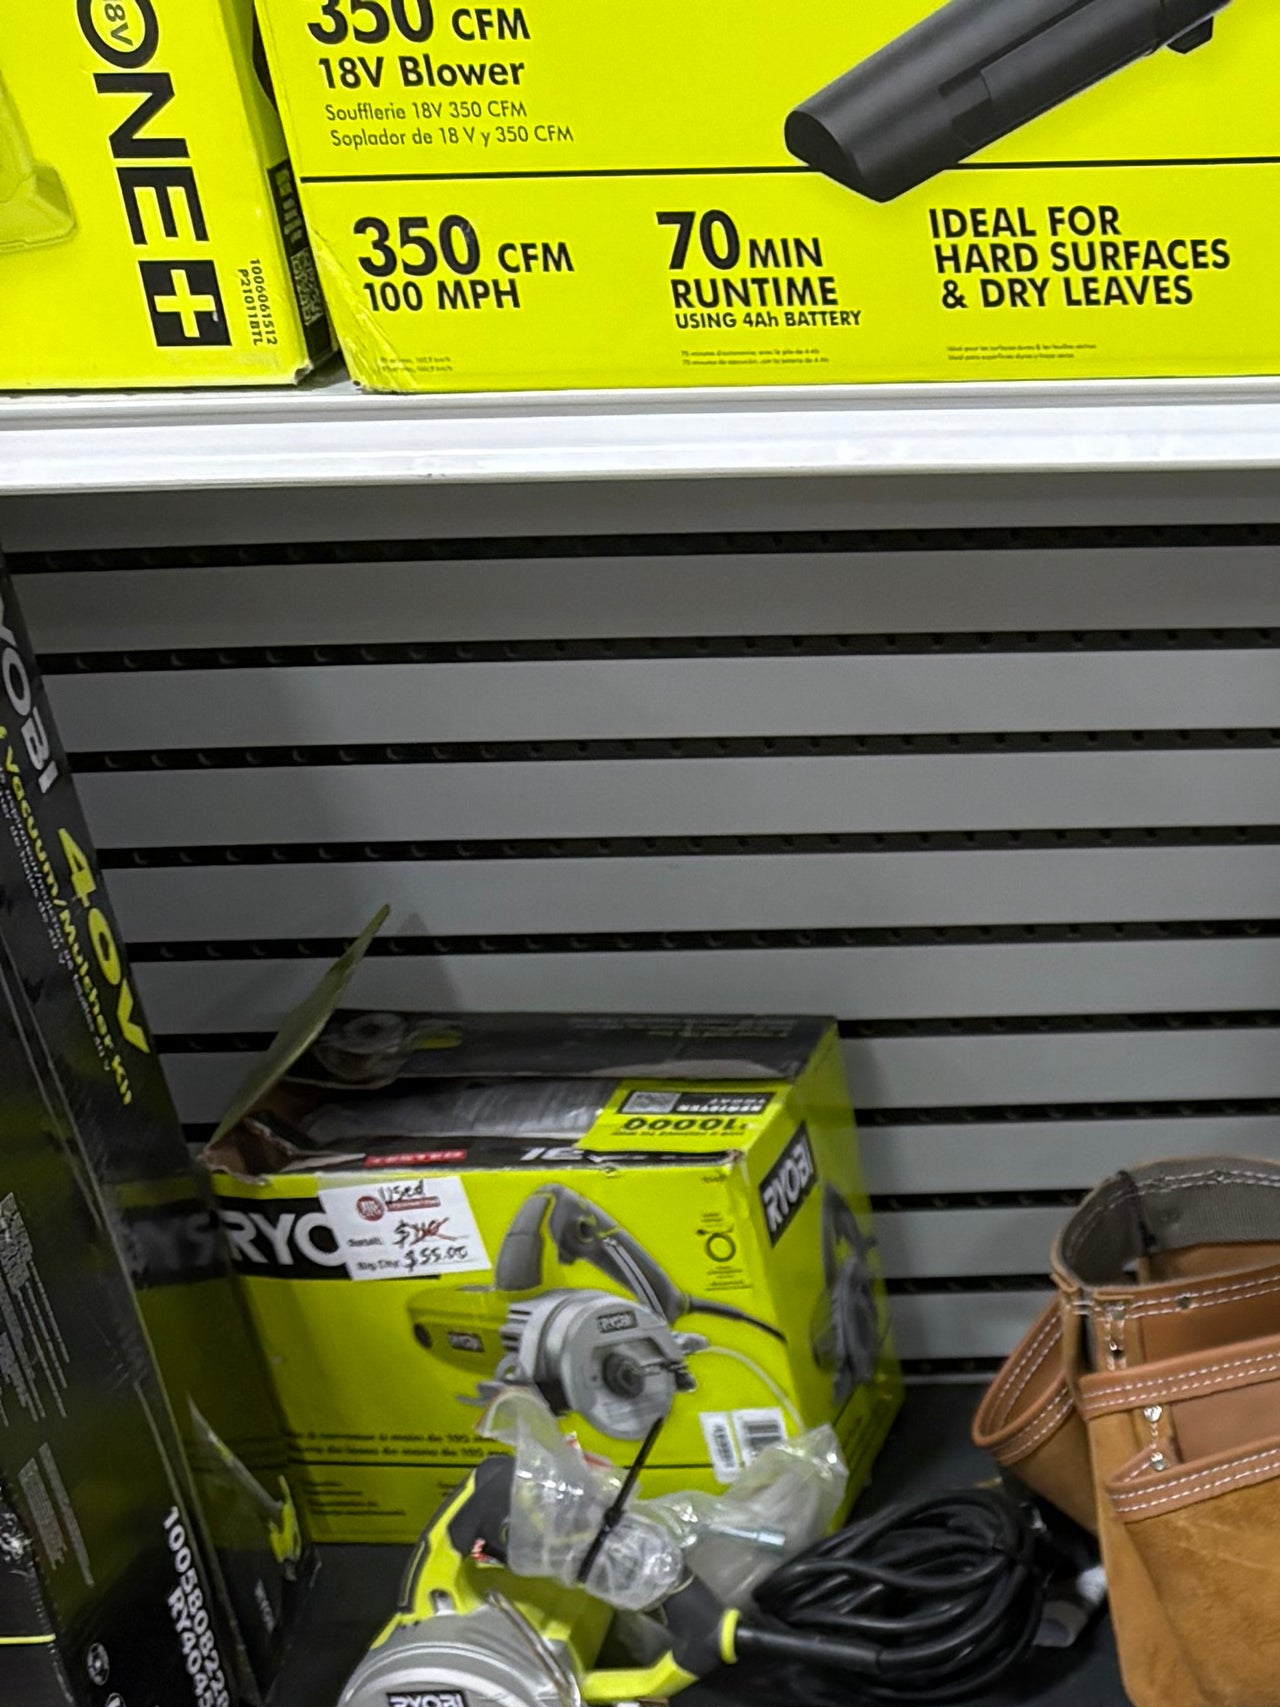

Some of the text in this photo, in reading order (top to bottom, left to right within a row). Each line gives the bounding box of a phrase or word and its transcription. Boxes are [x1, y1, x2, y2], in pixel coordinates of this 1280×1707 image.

[307, 0, 531, 45] 350 CFM
[318, 53, 525, 89] 18V Blower
[325, 100, 527, 121] Soufflerie 18V 350 CFM
[330, 125, 574, 150] Soplador de 18 V y 350 CFM
[655, 208, 823, 271] 70 MIN
[929, 205, 1122, 239] IDEAL FOR
[352, 213, 575, 278] 350 CFM
[934, 238, 1231, 274] HARD SURFACES
[364, 278, 521, 312] 100 MPH
[672, 276, 839, 309] RUNTIME
[941, 275, 1193, 309] & DRY LEAVES
[675, 310, 862, 330] USING 4Ah BATTERY
[58, 827, 151, 1055] 40V
[763, 1135, 816, 1232] RYOBI
